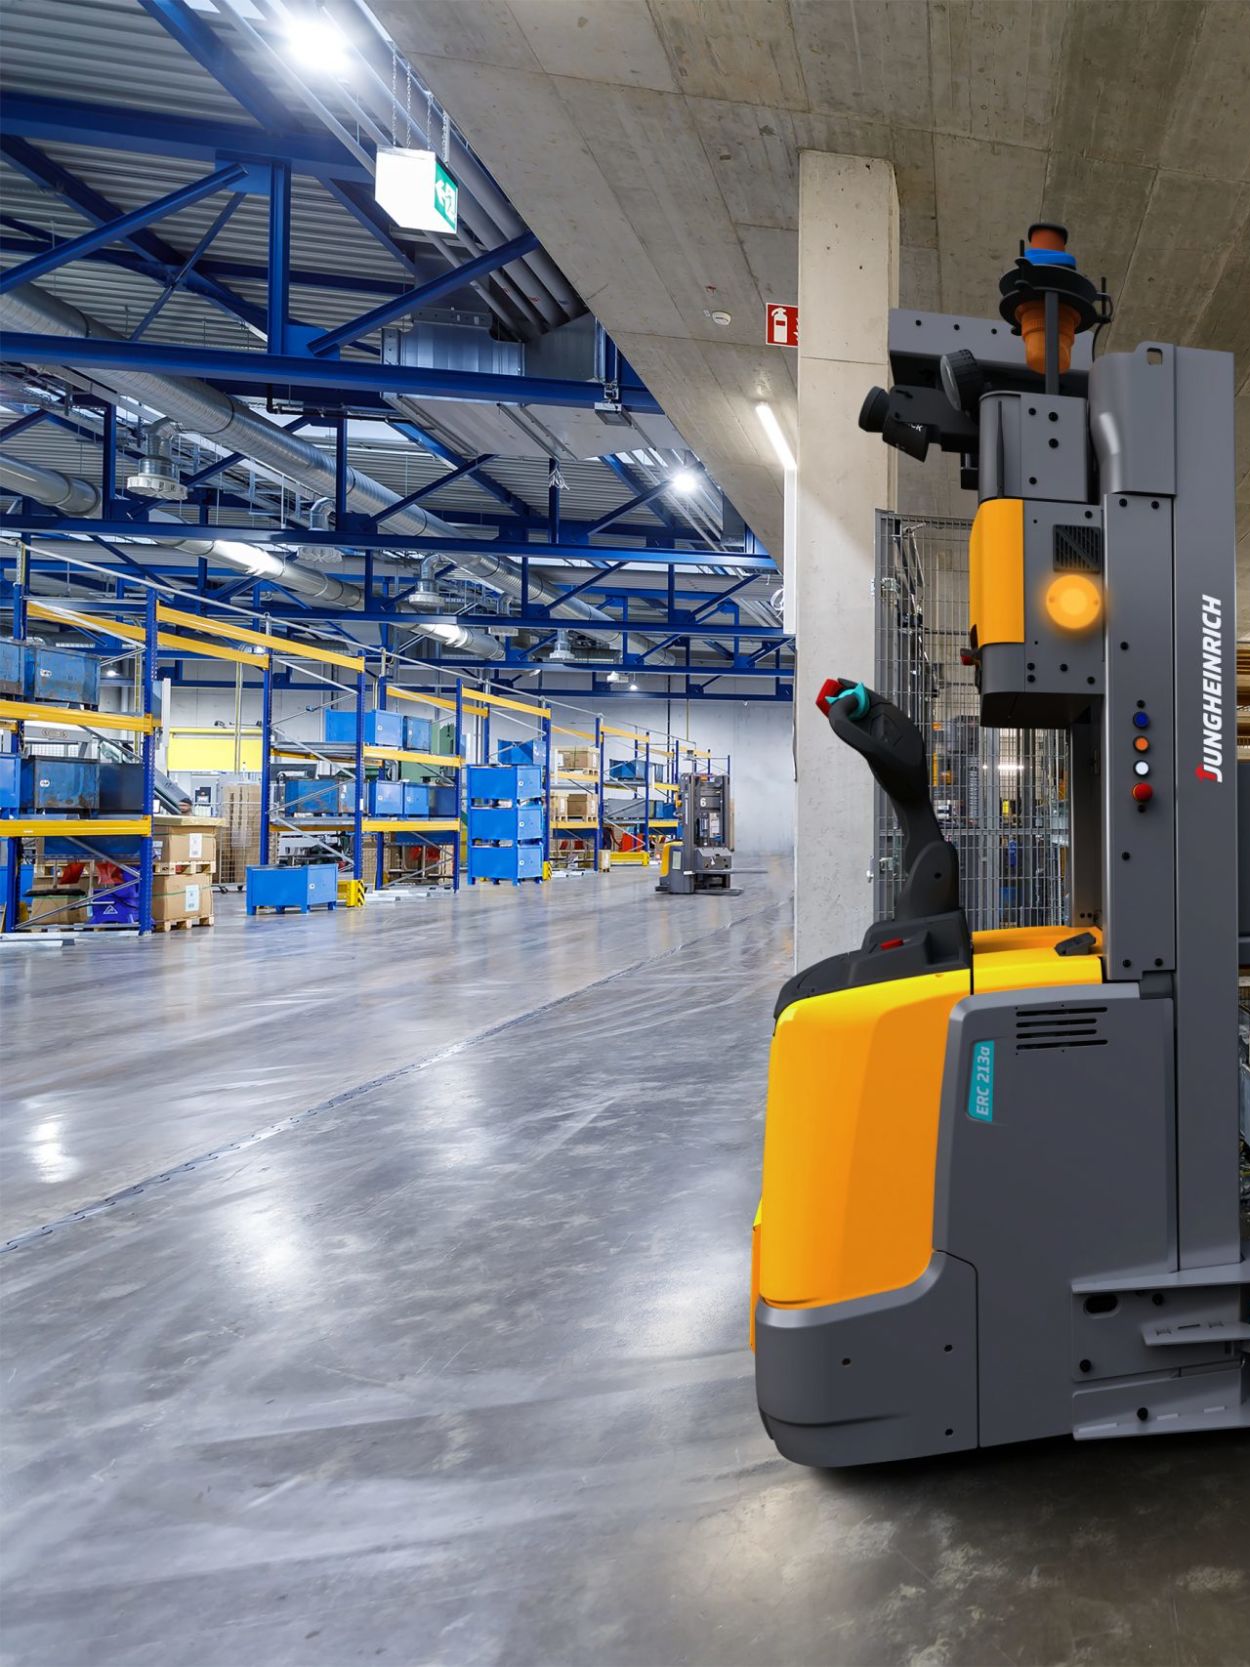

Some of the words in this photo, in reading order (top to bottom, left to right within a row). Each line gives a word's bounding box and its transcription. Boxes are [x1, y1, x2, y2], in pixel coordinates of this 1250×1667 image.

[1201, 594, 1223, 783] JUNGHEINRICH
[700, 798, 707, 807] 6
[976, 1046, 991, 1084] 213a
[976, 1085, 990, 1116] ERC
